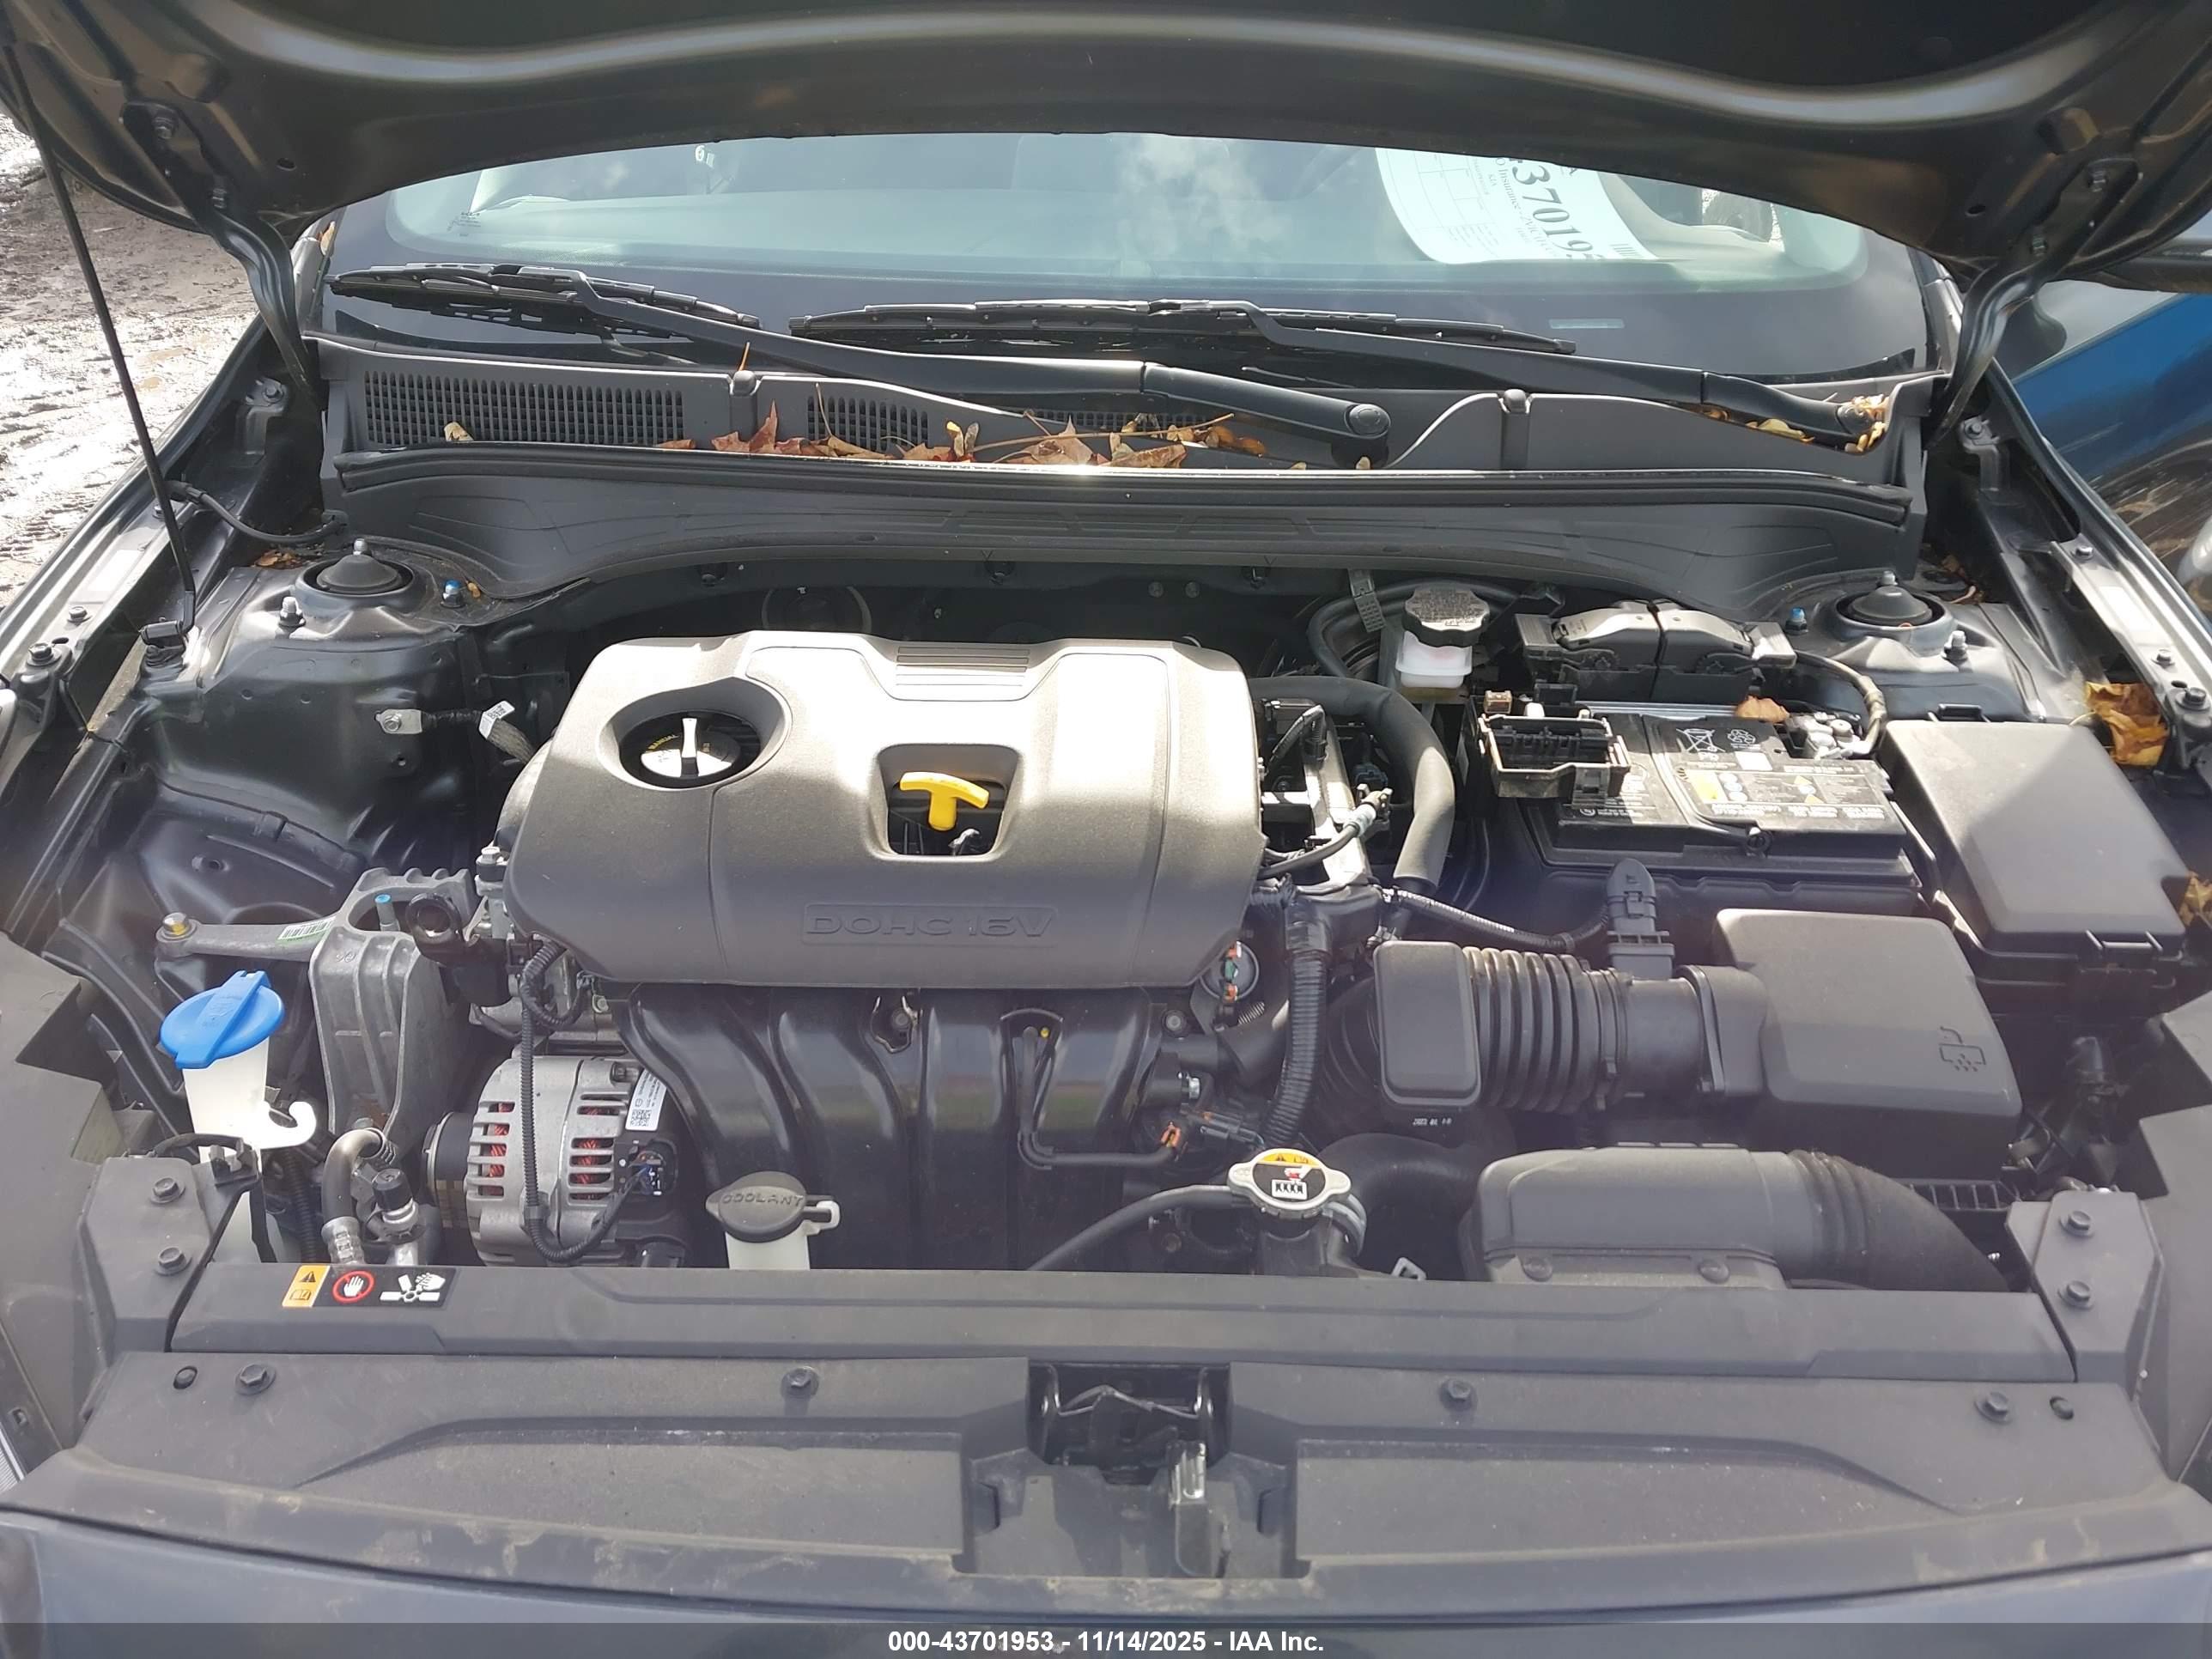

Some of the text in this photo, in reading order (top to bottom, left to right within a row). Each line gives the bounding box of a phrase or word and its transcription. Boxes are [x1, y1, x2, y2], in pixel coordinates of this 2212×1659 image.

[1509, 158, 1606, 259] 37019
[805, 915, 1054, 939] DOHC 16V
[722, 1192, 805, 1207] COOLANT
